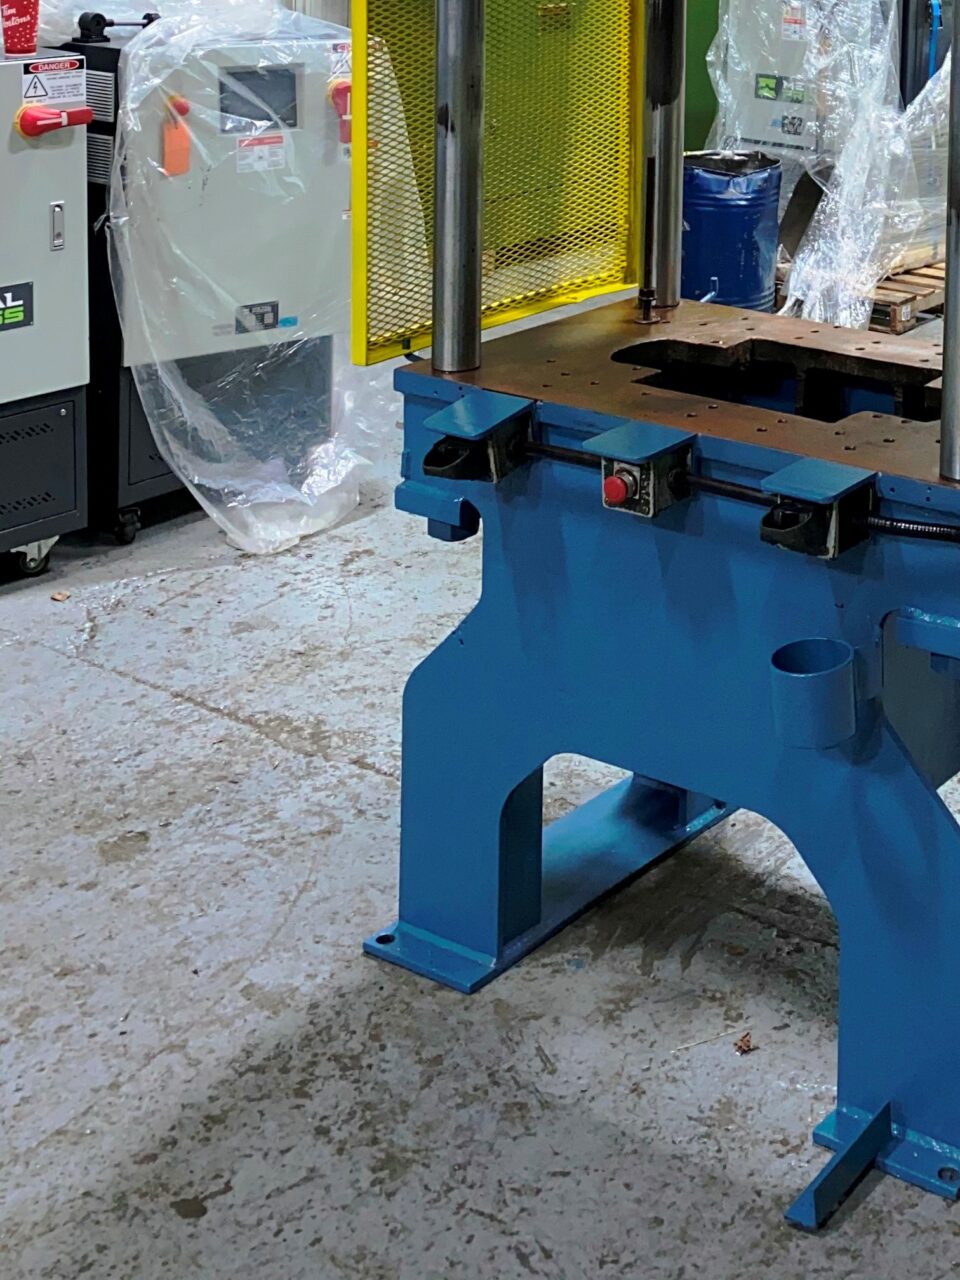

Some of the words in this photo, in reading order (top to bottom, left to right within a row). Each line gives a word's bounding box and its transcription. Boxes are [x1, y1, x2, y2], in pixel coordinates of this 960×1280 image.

[2, 4, 16, 16] Tim
[3, 14, 31, 28] ortons
[38, 62, 70, 71] DANGER
